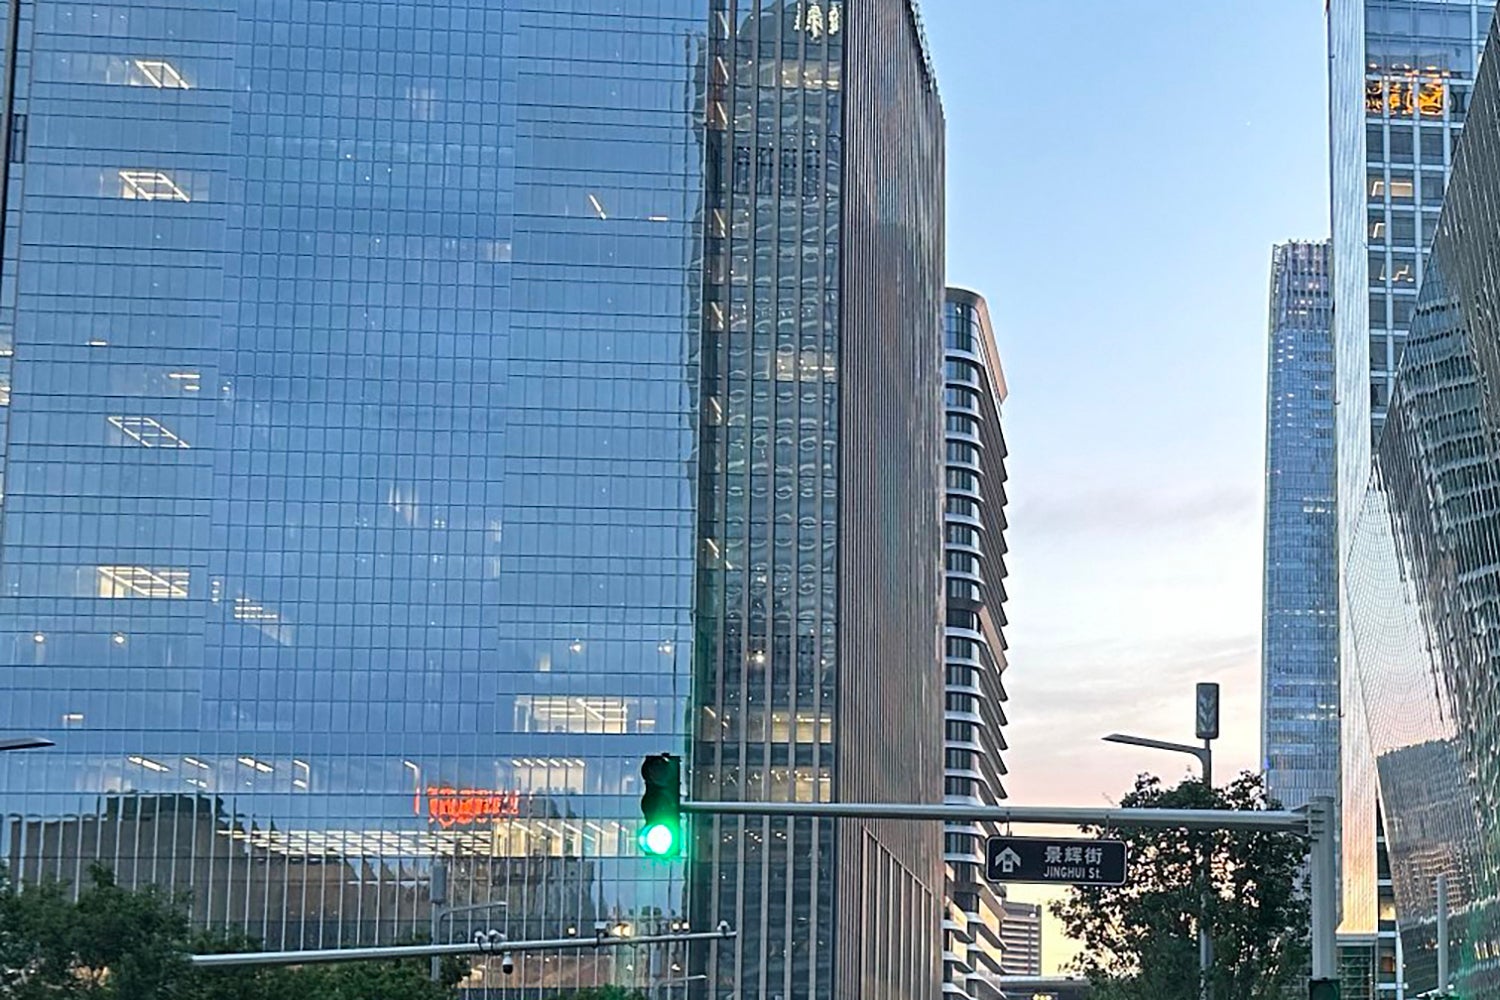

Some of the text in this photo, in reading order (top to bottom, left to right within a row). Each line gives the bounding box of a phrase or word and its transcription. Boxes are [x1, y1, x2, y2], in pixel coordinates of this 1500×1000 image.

[1044, 845, 1103, 865] 景辉街
[1043, 866, 1103, 880] JINGHUI St.
